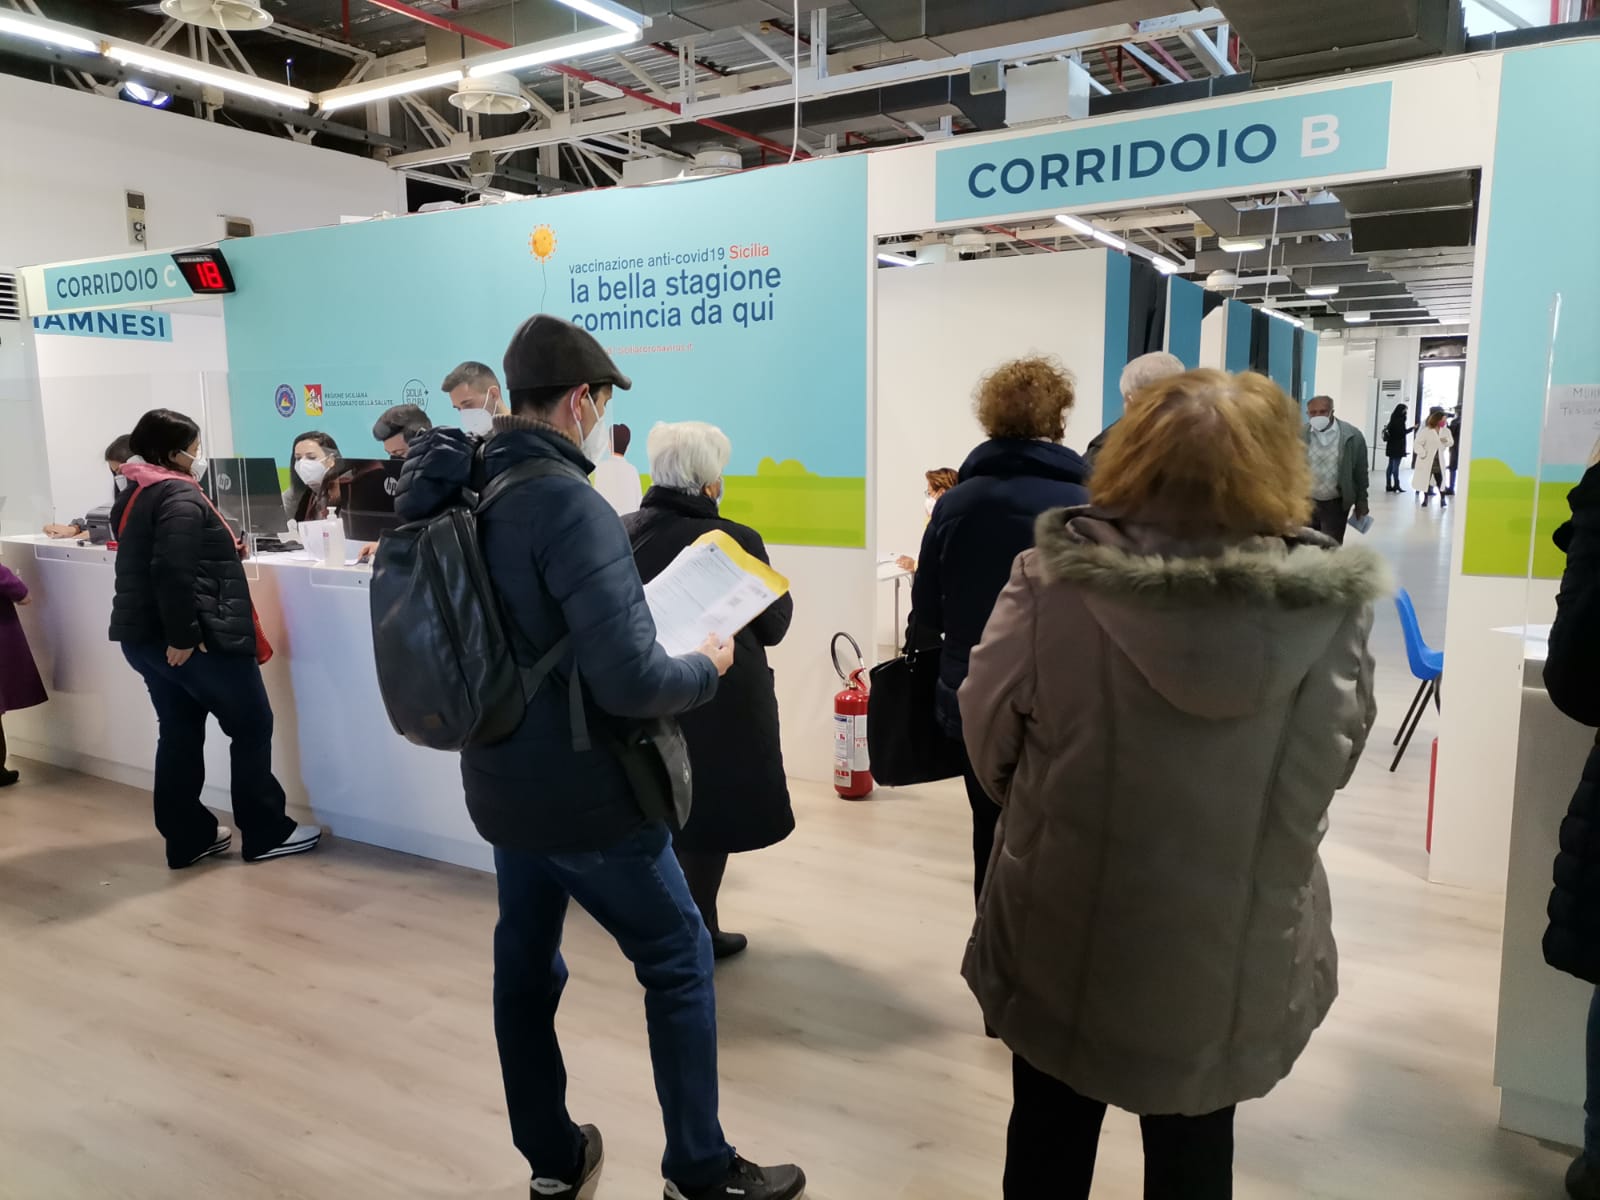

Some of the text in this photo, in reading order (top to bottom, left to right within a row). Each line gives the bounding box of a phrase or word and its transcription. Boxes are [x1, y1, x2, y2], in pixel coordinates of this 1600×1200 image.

[968, 114, 1340, 199] CORRIDOIO B
[196, 261, 224, 289] 18
[568, 243, 769, 274] vaccinazione anti-covid19 Sicilia
[56, 265, 177, 298] CORRIDOIO C
[570, 264, 782, 303] la bella stagione
[690, 298, 722, 325] da
[732, 292, 774, 328] qui
